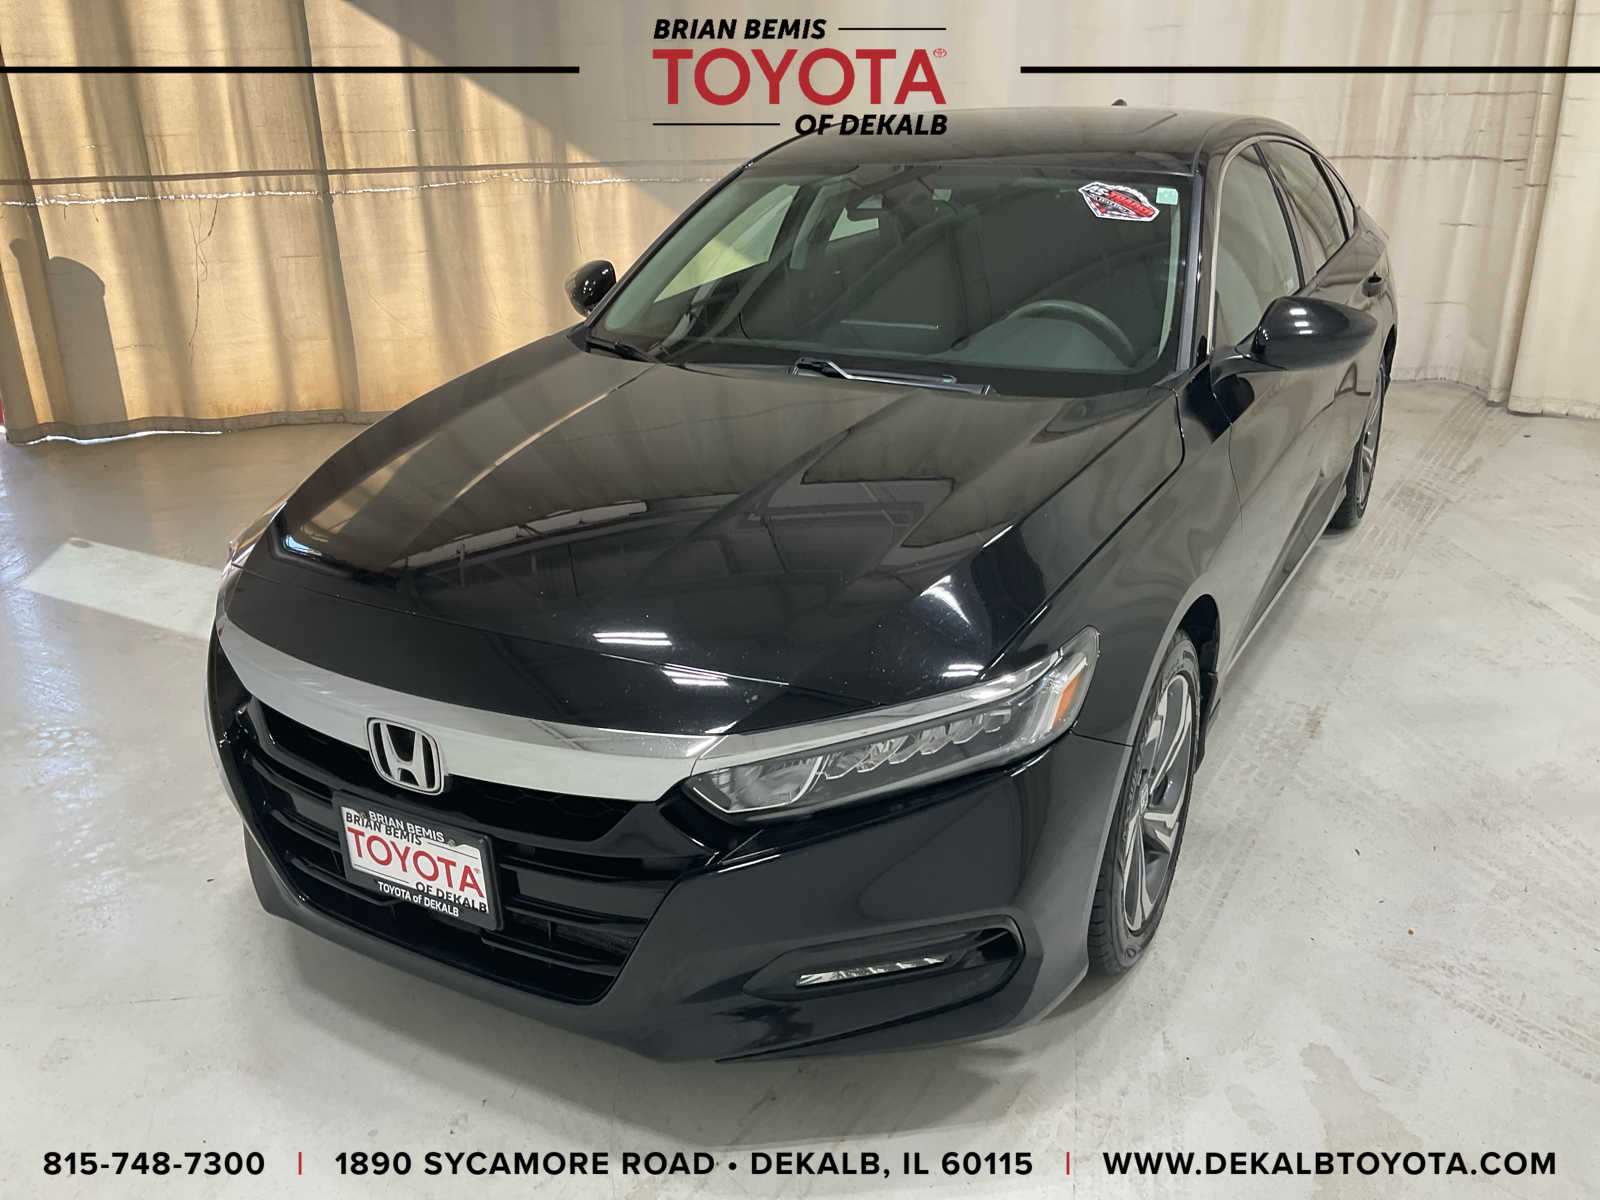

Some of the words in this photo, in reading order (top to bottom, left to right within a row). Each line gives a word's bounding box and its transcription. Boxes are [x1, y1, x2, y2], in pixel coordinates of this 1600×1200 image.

[346, 812, 382, 833] BRIAN
[386, 826, 423, 846] BEMIS
[368, 810, 403, 829] BRIAN
[407, 822, 445, 843] BEMIS
[347, 826, 485, 898] TOYOTA
[377, 881, 412, 901] TOYOTA
[423, 897, 460, 918] DEKALB
[436, 887, 487, 913] DEKALB
